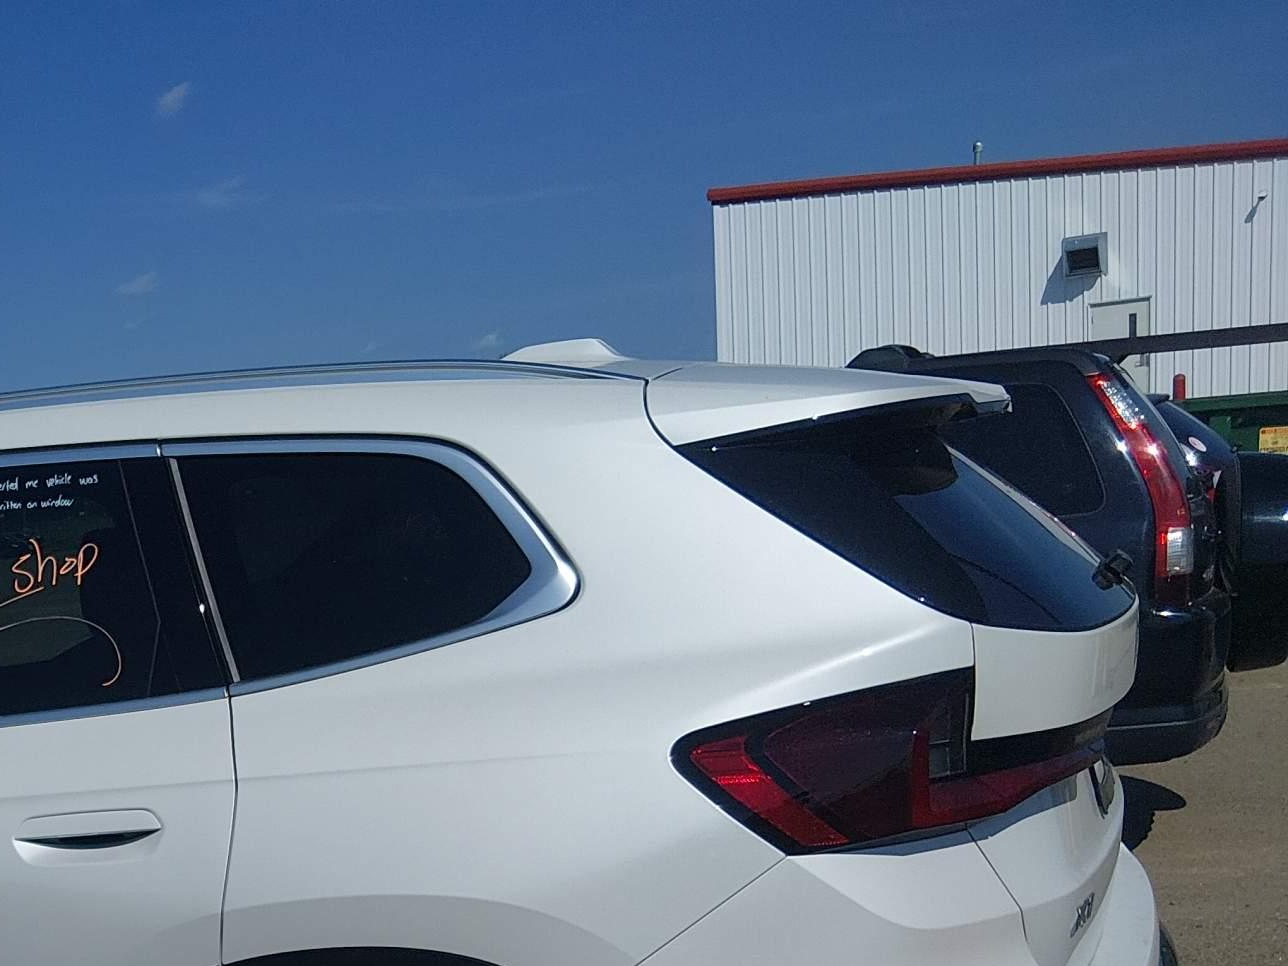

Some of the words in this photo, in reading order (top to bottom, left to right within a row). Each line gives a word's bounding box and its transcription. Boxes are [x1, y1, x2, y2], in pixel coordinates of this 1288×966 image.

[25, 479, 38, 489] me
[46, 473, 72, 488] vehicle
[79, 474, 99, 486] was
[27, 501, 38, 509] on
[41, 495, 73, 508] window
